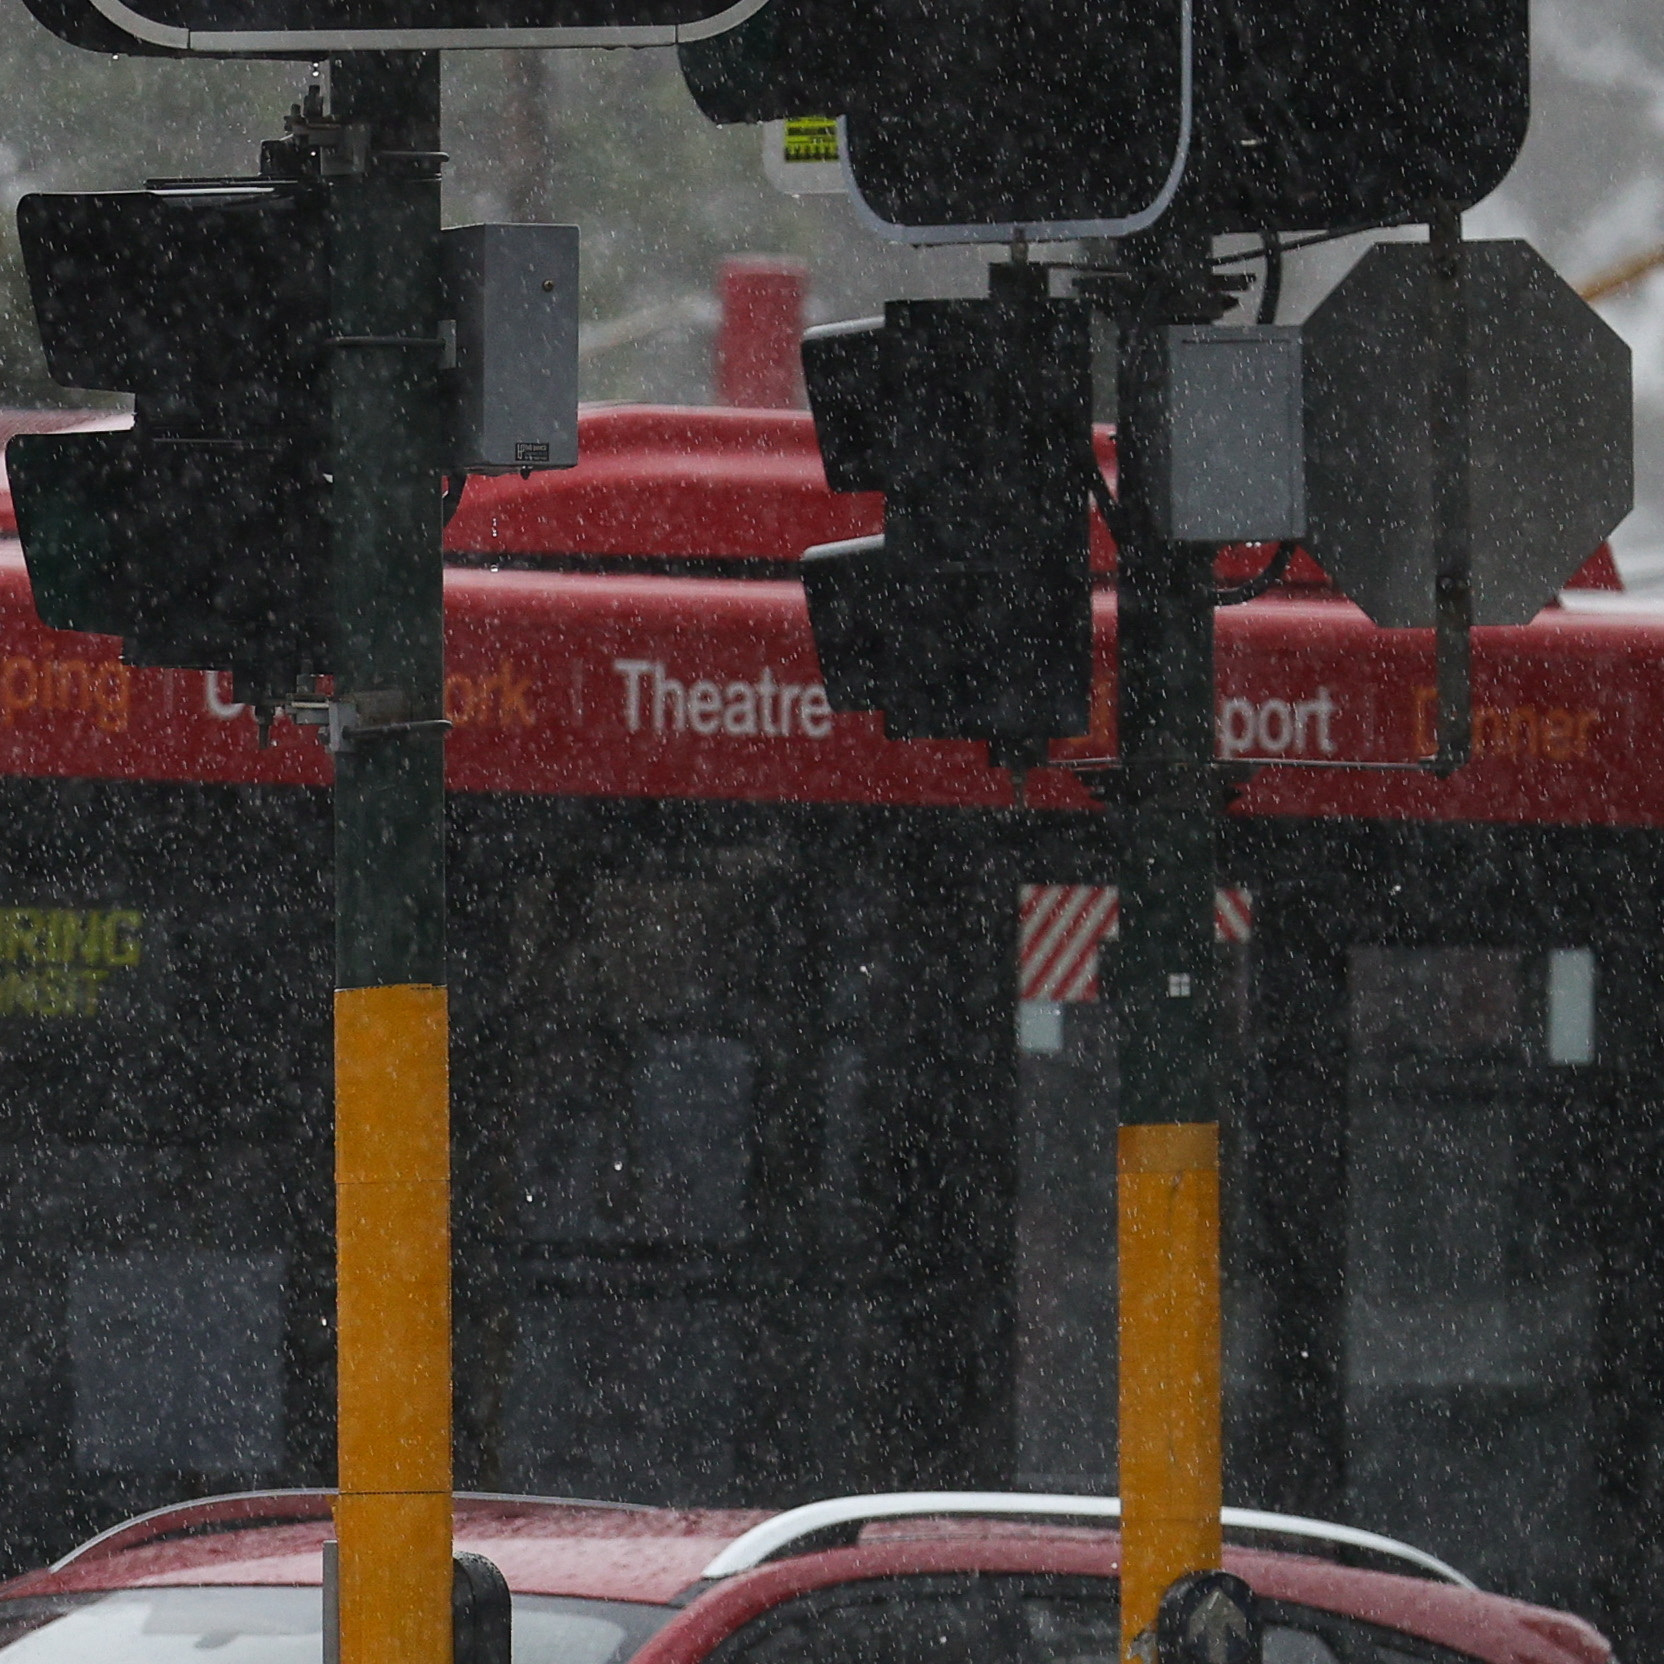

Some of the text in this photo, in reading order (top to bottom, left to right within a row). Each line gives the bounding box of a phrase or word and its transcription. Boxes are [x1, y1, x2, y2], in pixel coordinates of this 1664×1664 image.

[444, 660, 535, 728] ork
[612, 657, 833, 738] Theatre
[1217, 686, 1341, 759] port
[1413, 685, 1602, 761] Dnner
